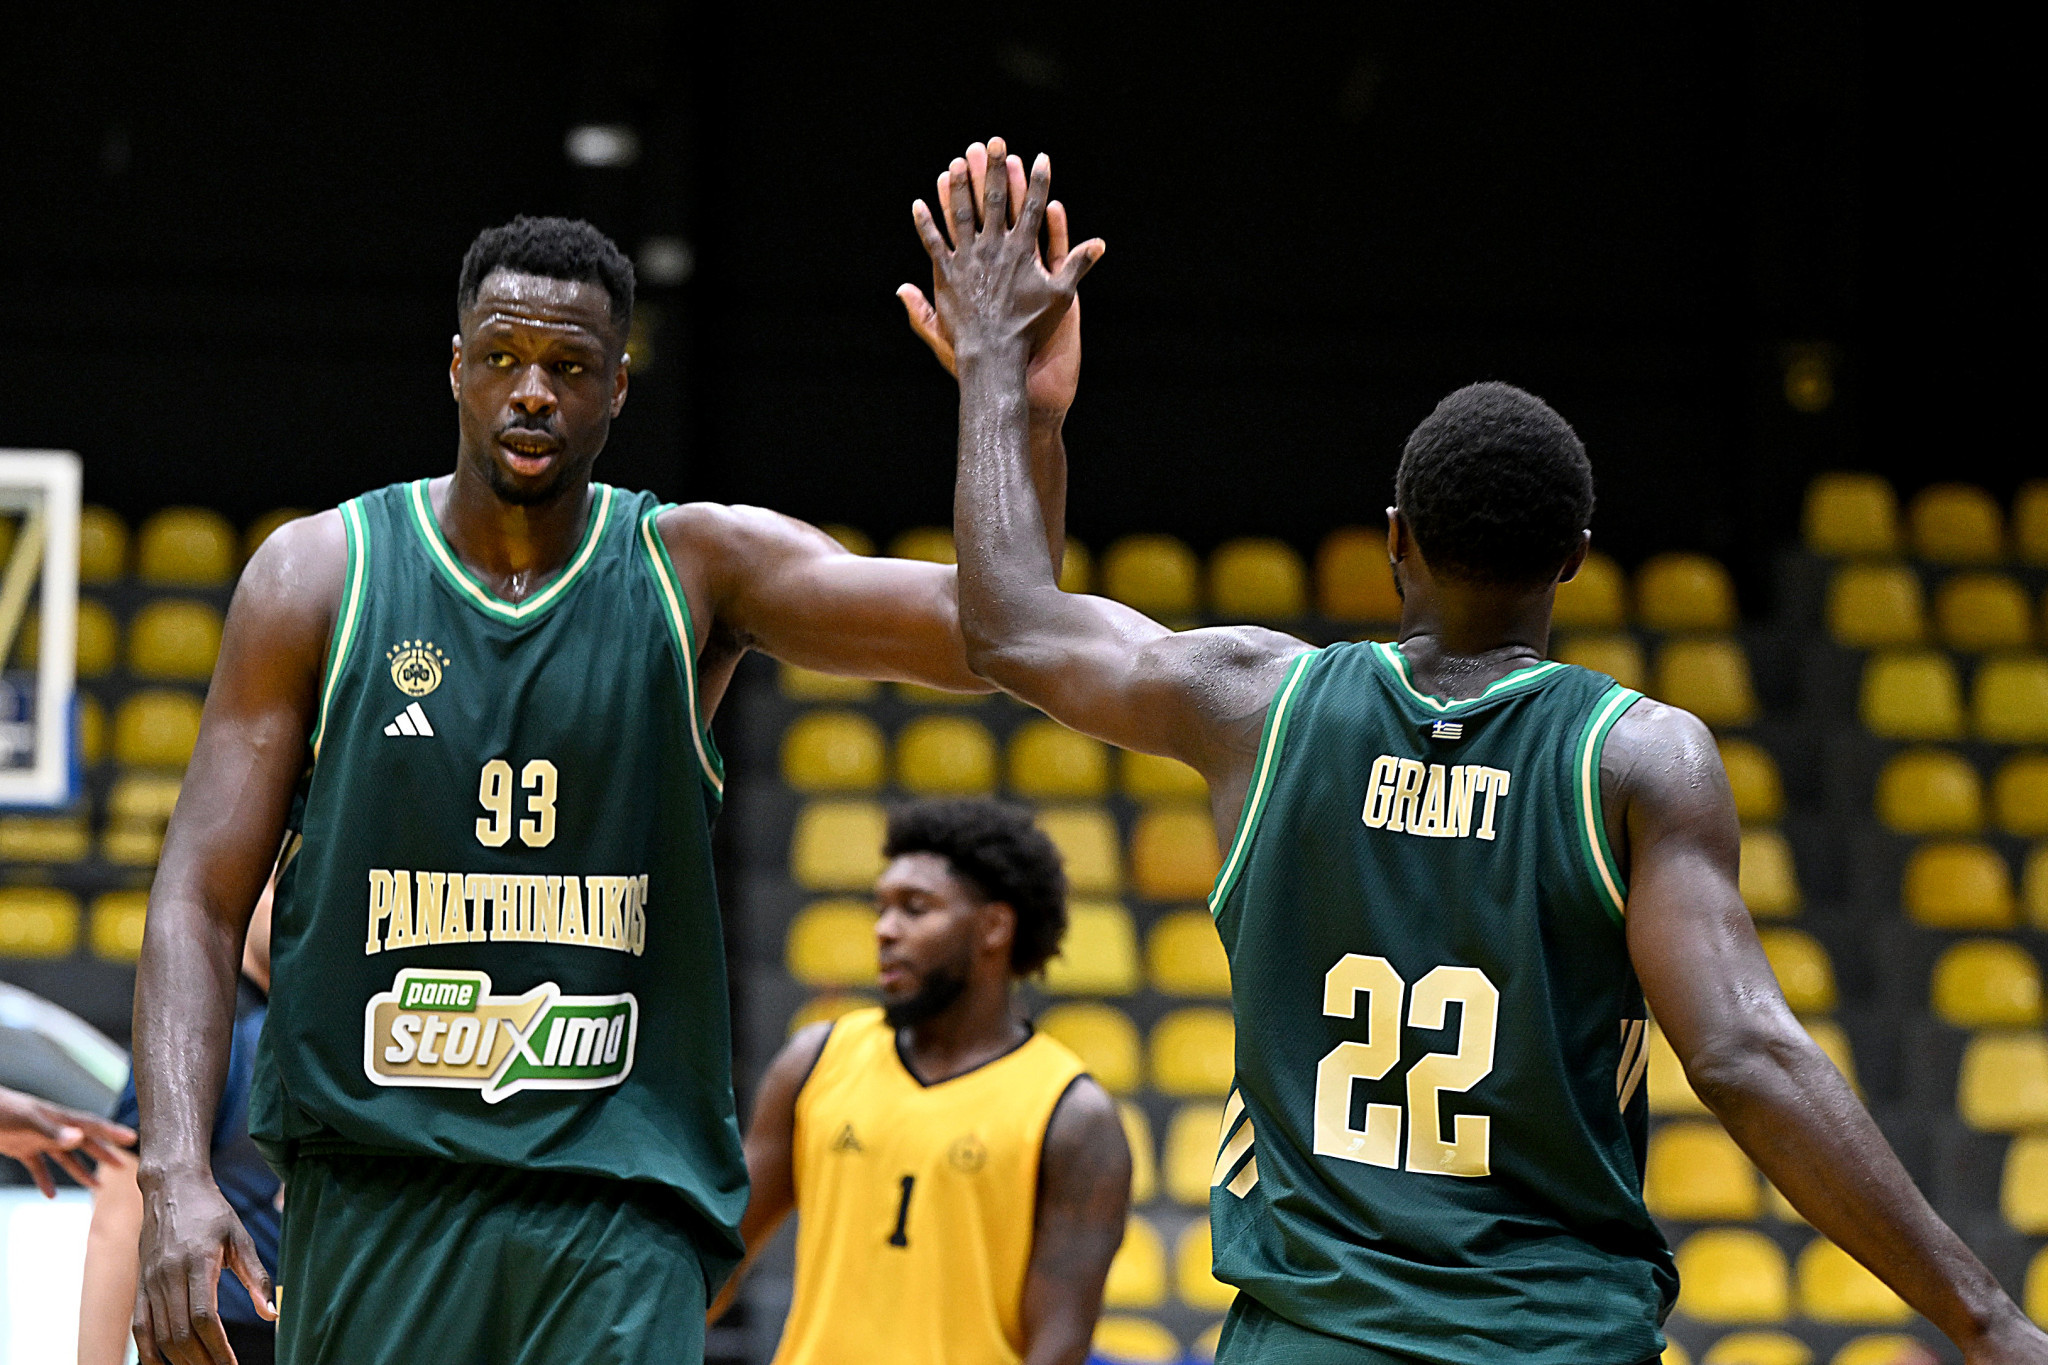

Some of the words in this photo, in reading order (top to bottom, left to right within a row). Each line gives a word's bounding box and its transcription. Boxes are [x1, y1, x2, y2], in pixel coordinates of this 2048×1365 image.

[476, 759, 558, 847] 93
[1362, 754, 1510, 841] GRANT
[366, 868, 648, 957] PANATHINAIKOS
[405, 982, 473, 1007] pame
[1313, 953, 1500, 1177] 22
[888, 1174, 915, 1248] 1
